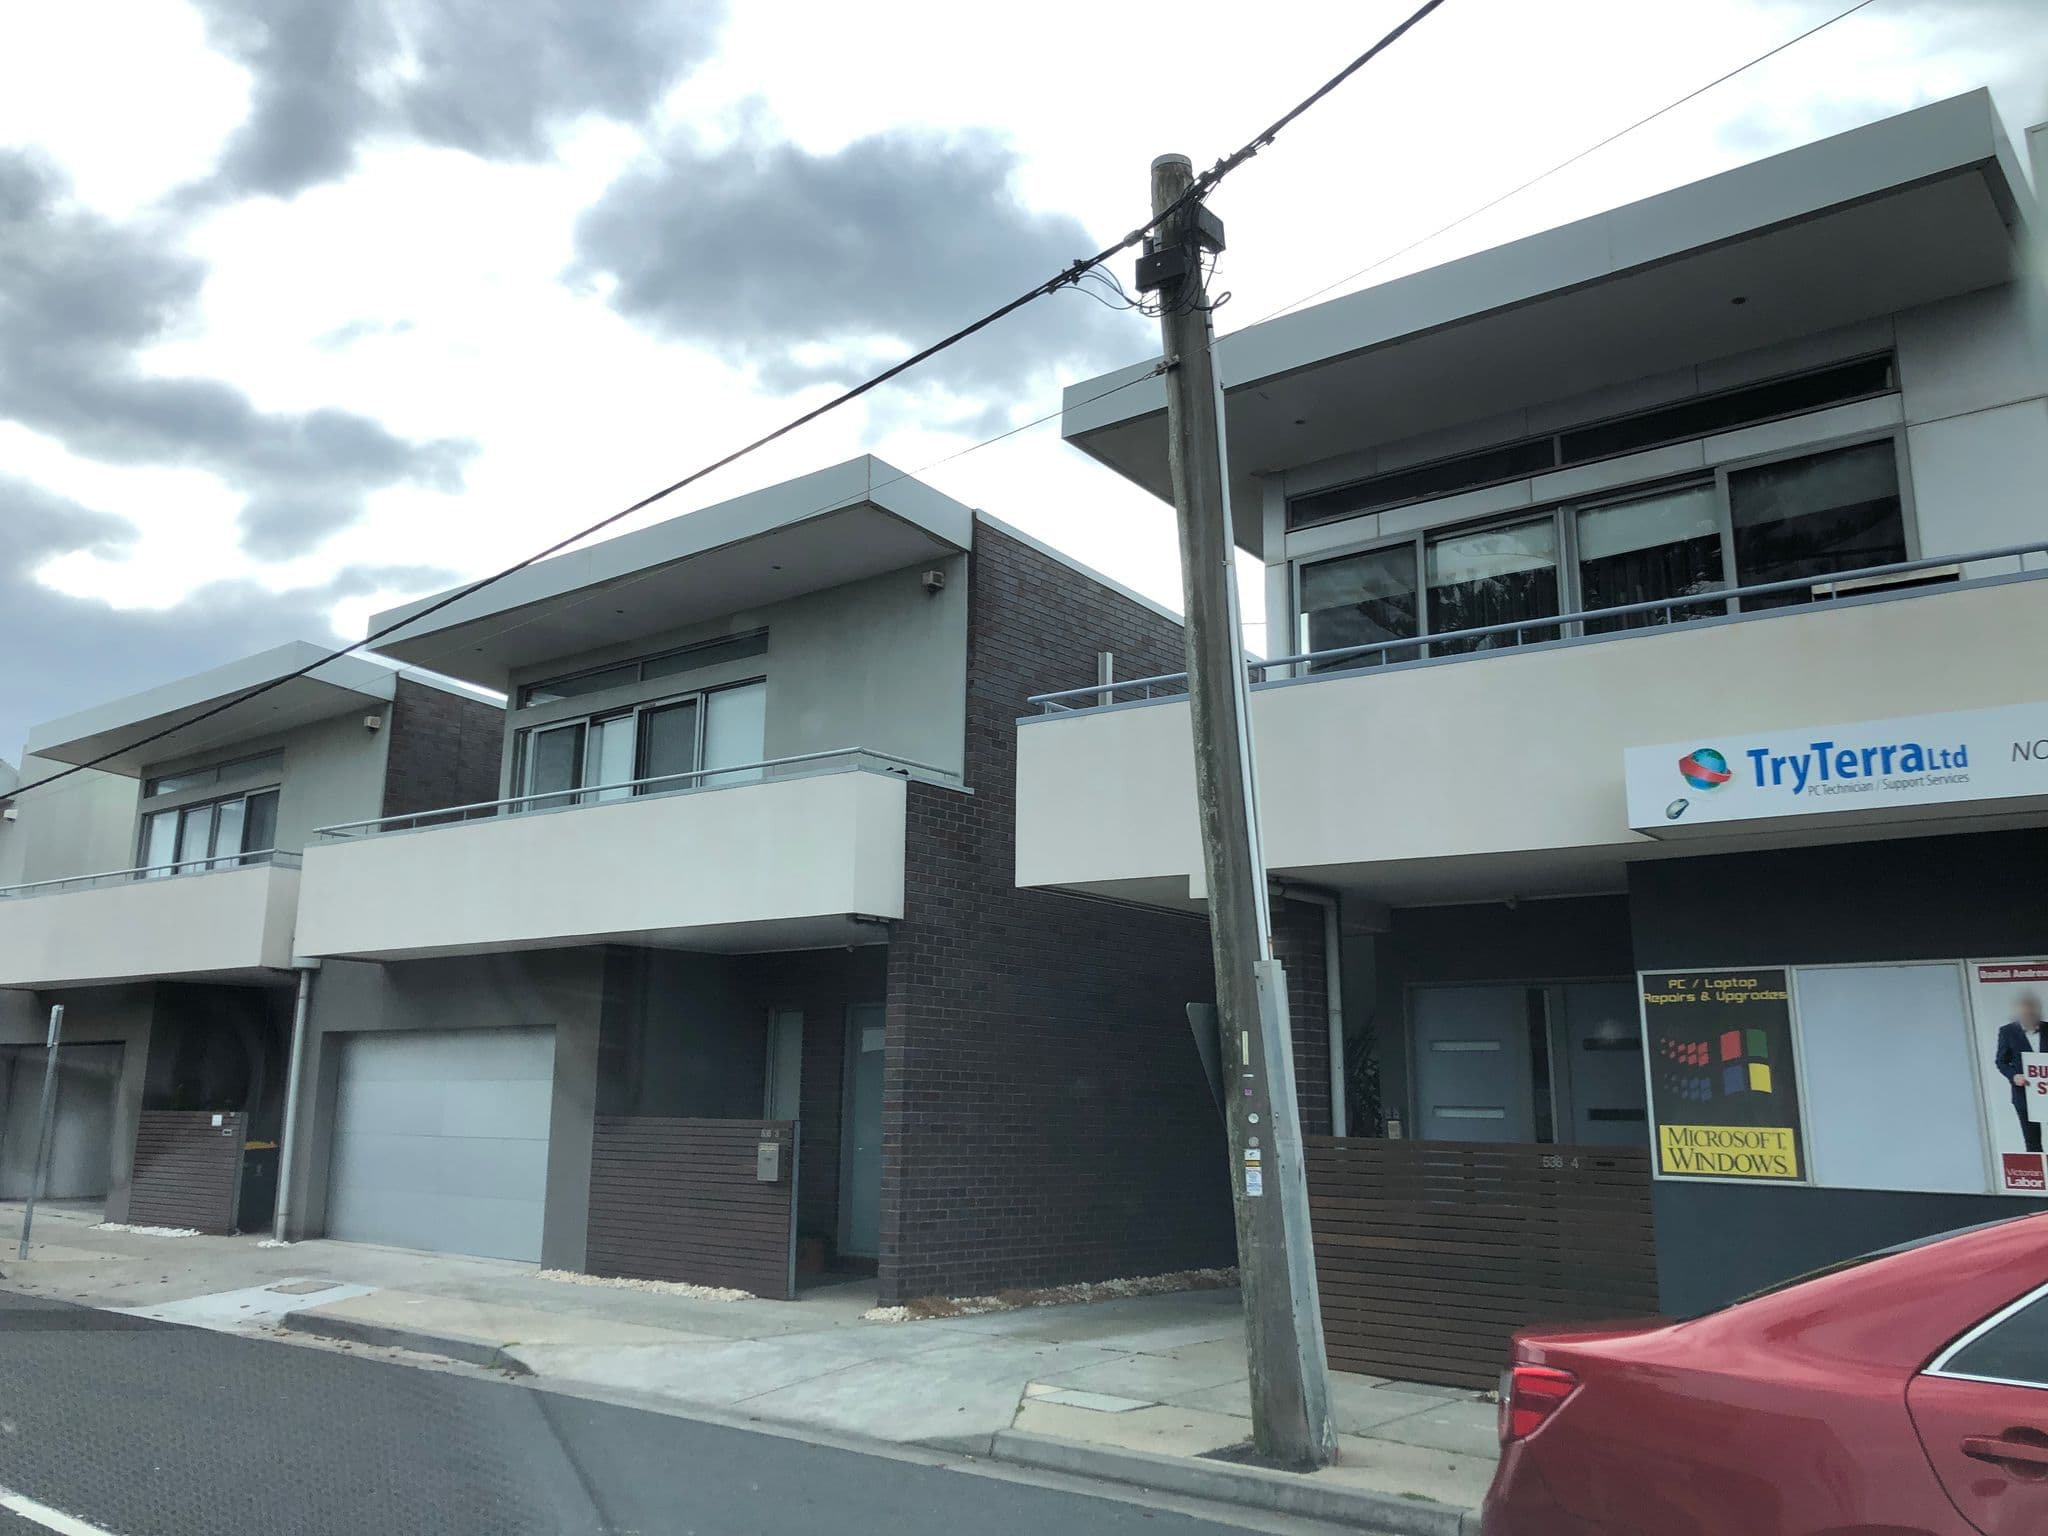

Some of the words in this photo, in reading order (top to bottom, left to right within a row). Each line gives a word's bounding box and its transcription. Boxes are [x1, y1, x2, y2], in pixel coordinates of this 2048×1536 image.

[1746, 741, 1924, 795] TryTerra
[1927, 744, 1968, 771] Ltd
[1821, 781, 1874, 795] Technician
[1882, 777, 1925, 791] Support
[1926, 773, 1969, 787] Services
[1667, 978, 1686, 989] PC
[1704, 977, 1758, 990] Laptop
[1643, 992, 1696, 1005] Repairs
[1700, 991, 1711, 1002] &
[1716, 990, 1789, 1004] Upgrades
[2037, 1081, 2048, 1095] S
[1667, 1127, 1786, 1150] MICROSOFT
[1666, 1147, 1788, 1175] WINDOWS
[2006, 1176, 2044, 1188] Labor
